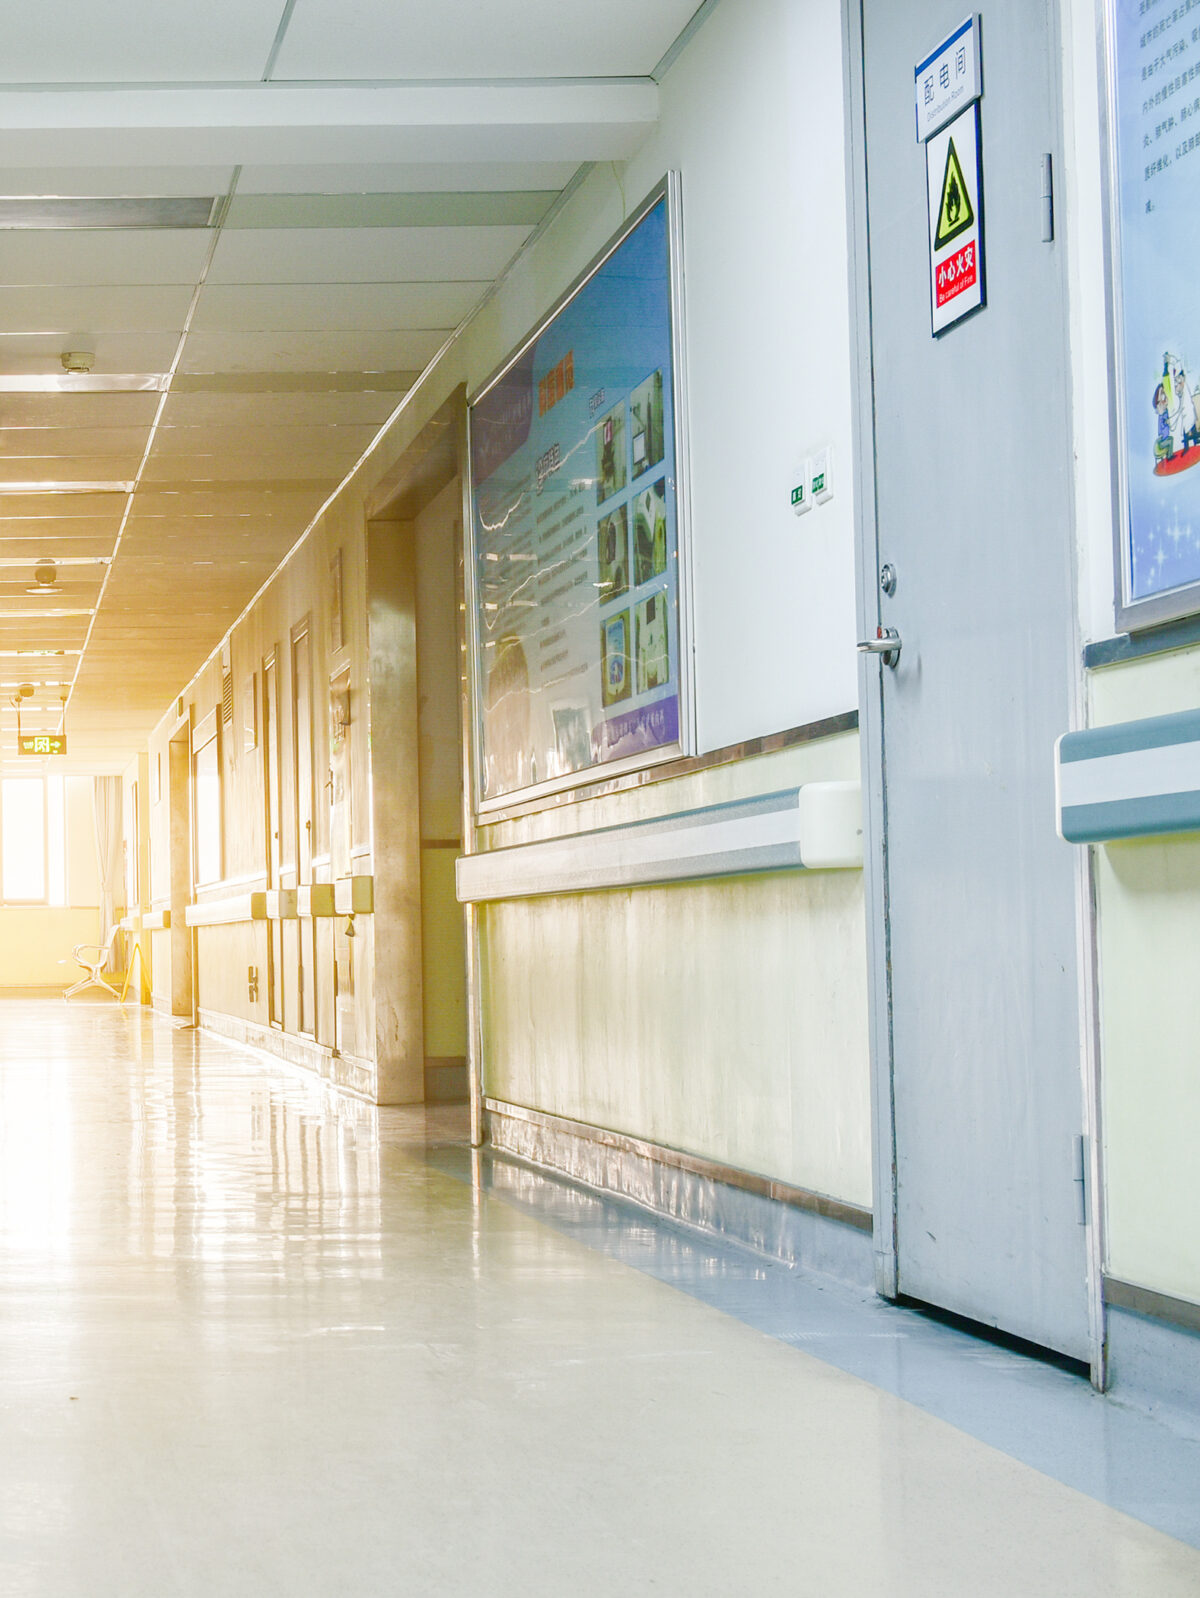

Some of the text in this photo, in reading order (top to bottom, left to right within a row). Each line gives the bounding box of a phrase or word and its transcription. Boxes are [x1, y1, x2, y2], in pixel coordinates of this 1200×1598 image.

[924, 46, 966, 107] 配电间
[938, 246, 974, 288] 小心火灾
